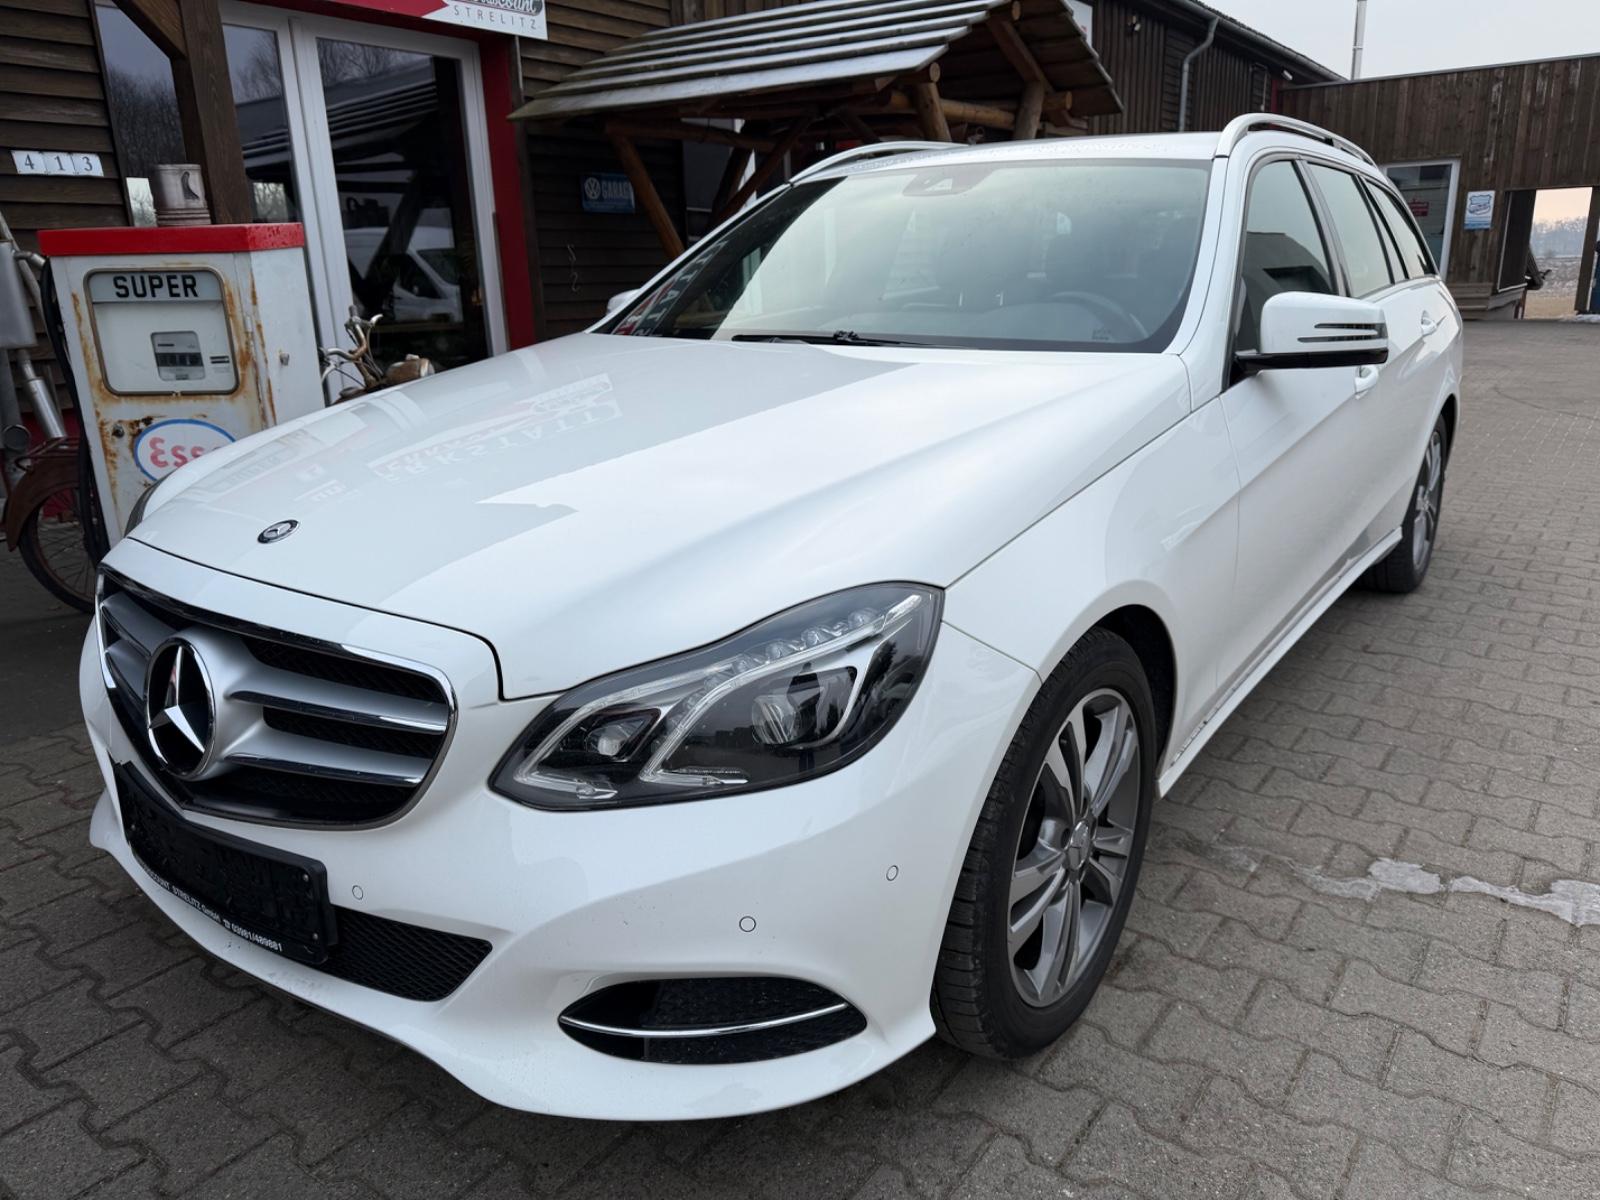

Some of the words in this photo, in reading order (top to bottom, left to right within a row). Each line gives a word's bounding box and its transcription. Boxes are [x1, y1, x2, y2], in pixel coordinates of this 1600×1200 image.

[453, 5, 537, 30] STRELITZ
[24, 154, 93, 172] 413
[112, 274, 199, 298] SUPER
[149, 437, 208, 468] Ess
